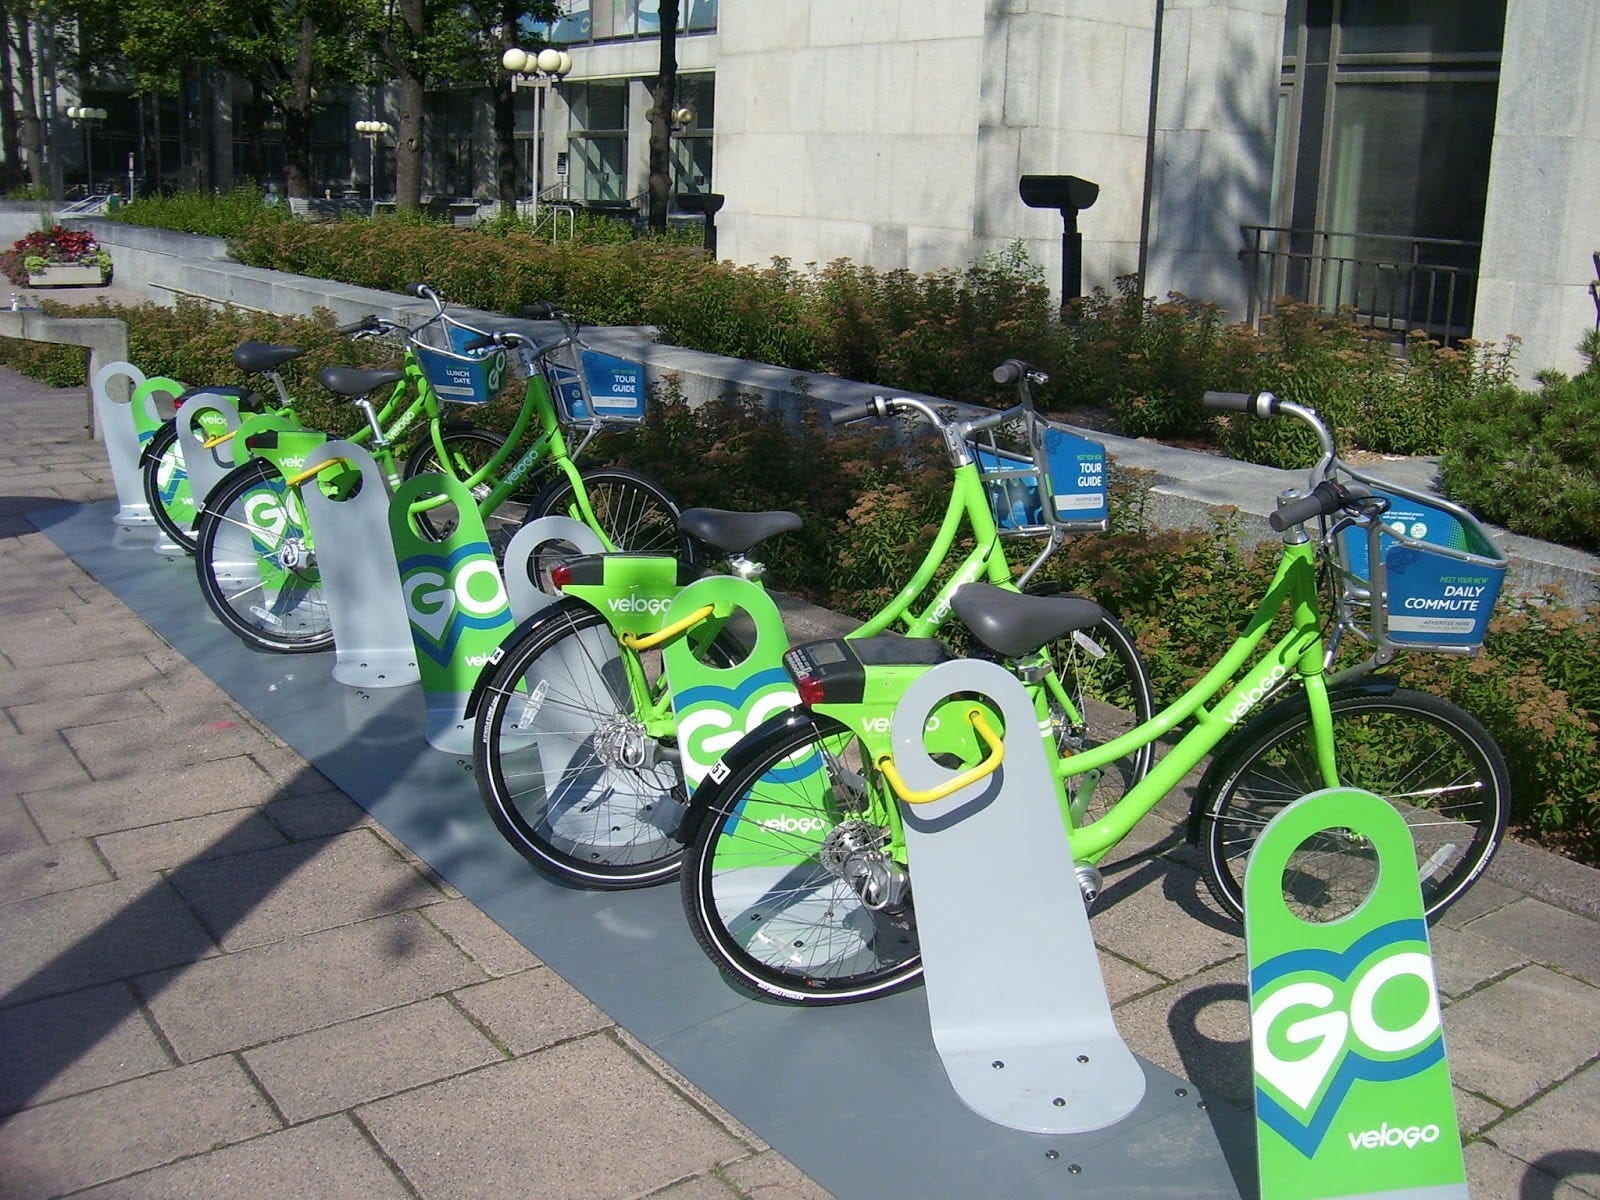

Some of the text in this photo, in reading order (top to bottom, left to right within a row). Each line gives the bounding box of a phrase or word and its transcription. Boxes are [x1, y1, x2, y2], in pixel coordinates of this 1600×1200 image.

[446, 369, 470, 377] LUNCH
[614, 375, 636, 383] TOUR
[612, 384, 636, 393] GUIDE
[1080, 463, 1102, 473] TOUR
[1078, 476, 1102, 487] GUIDE
[1444, 585, 1485, 597] DAILY
[403, 559, 509, 641] GO
[1404, 598, 1480, 611] COMMUTE
[1252, 951, 1441, 1111] GO
